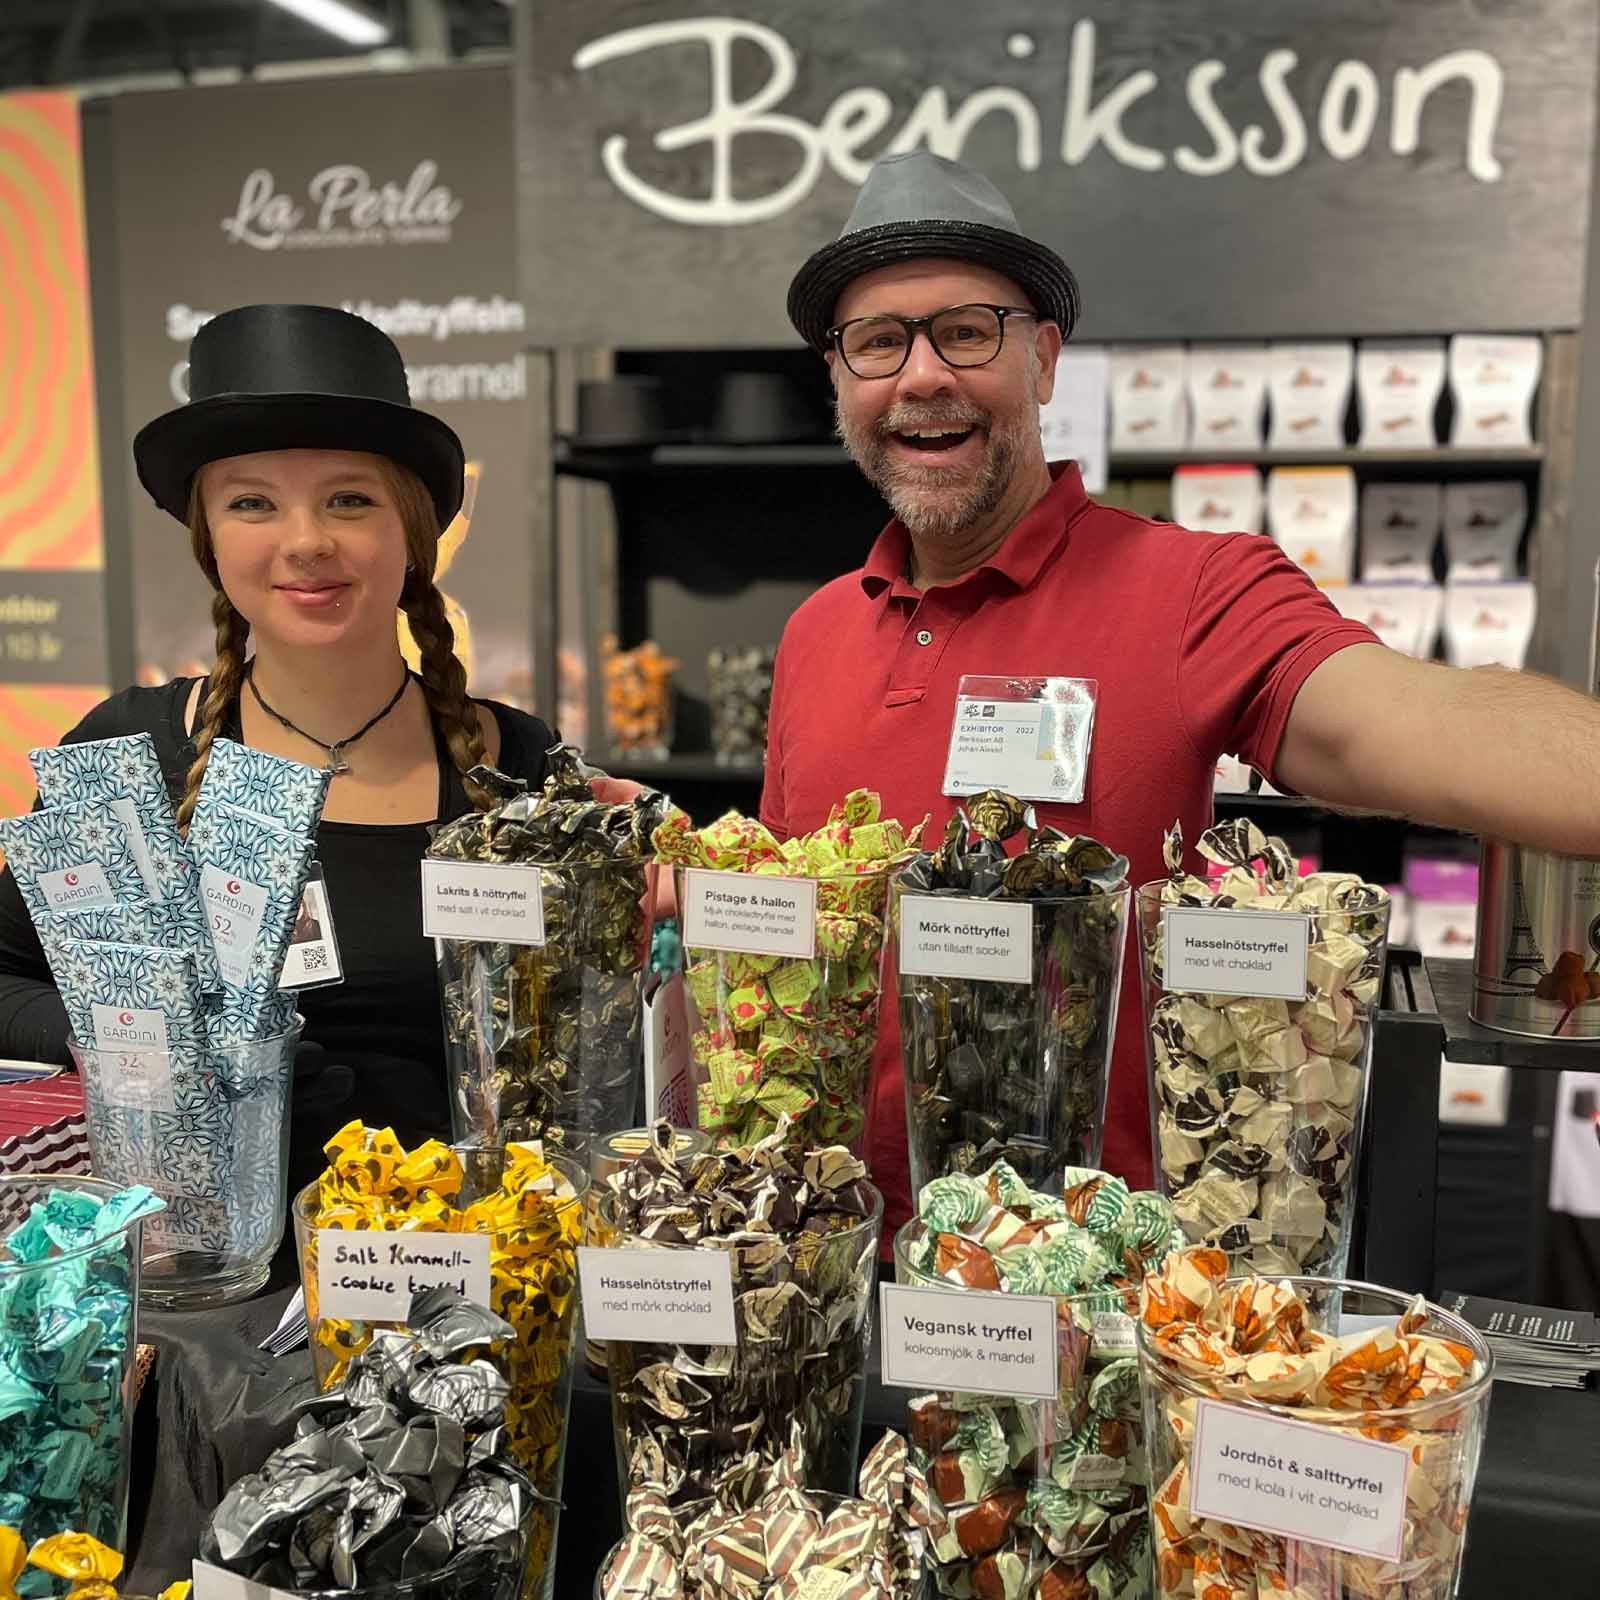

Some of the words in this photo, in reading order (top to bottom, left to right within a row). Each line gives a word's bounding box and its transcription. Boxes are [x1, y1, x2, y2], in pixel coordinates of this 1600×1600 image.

[220, 168, 304, 250] La
[308, 158, 463, 234] Perla
[960, 725, 1004, 733] EXHIBITOR
[53, 884, 102, 903] GARDINI
[437, 884, 470, 897] Lakrits
[473, 887, 480, 897] &
[482, 888, 527, 901] nöttryffel
[705, 891, 747, 906] Pistage
[750, 895, 758, 905] &
[761, 897, 796, 909] hallon
[206, 887, 256, 916] GARDINI
[436, 904, 456, 913] med
[491, 908, 526, 918] choklad
[777, 914, 796, 922] med
[920, 921, 951, 934] Mörk
[954, 924, 1010, 939] nöttryffel
[918, 943, 941, 952] utan
[944, 943, 973, 954] tillsatt
[975, 946, 1011, 957] socker
[1185, 937, 1288, 954] Hasselnötstryffel
[1184, 957, 1209, 967] med
[1212, 958, 1225, 968] vit
[1228, 959, 1272, 971] choklad
[103, 1026, 157, 1041] GARDINI
[335, 1245, 378, 1264] Salt
[600, 1277, 712, 1293] Hasselnötstryffel
[602, 1300, 628, 1311] med
[631, 1301, 662, 1312] mörk
[665, 1301, 711, 1313] choklad
[904, 1316, 977, 1336] Vegansk
[982, 1324, 1032, 1342] tryffel
[904, 1340, 973, 1360] kokosmjölk
[977, 1349, 986, 1360] &
[988, 1350, 1035, 1364] mandel
[1219, 1444, 1283, 1471] Jordnöt
[1287, 1461, 1299, 1474] &
[1304, 1464, 1383, 1494] salttryffel
[1217, 1471, 1250, 1489] med
[1254, 1476, 1285, 1497] kola
[1298, 1491, 1314, 1505] vit
[1318, 1494, 1379, 1520] choklad
